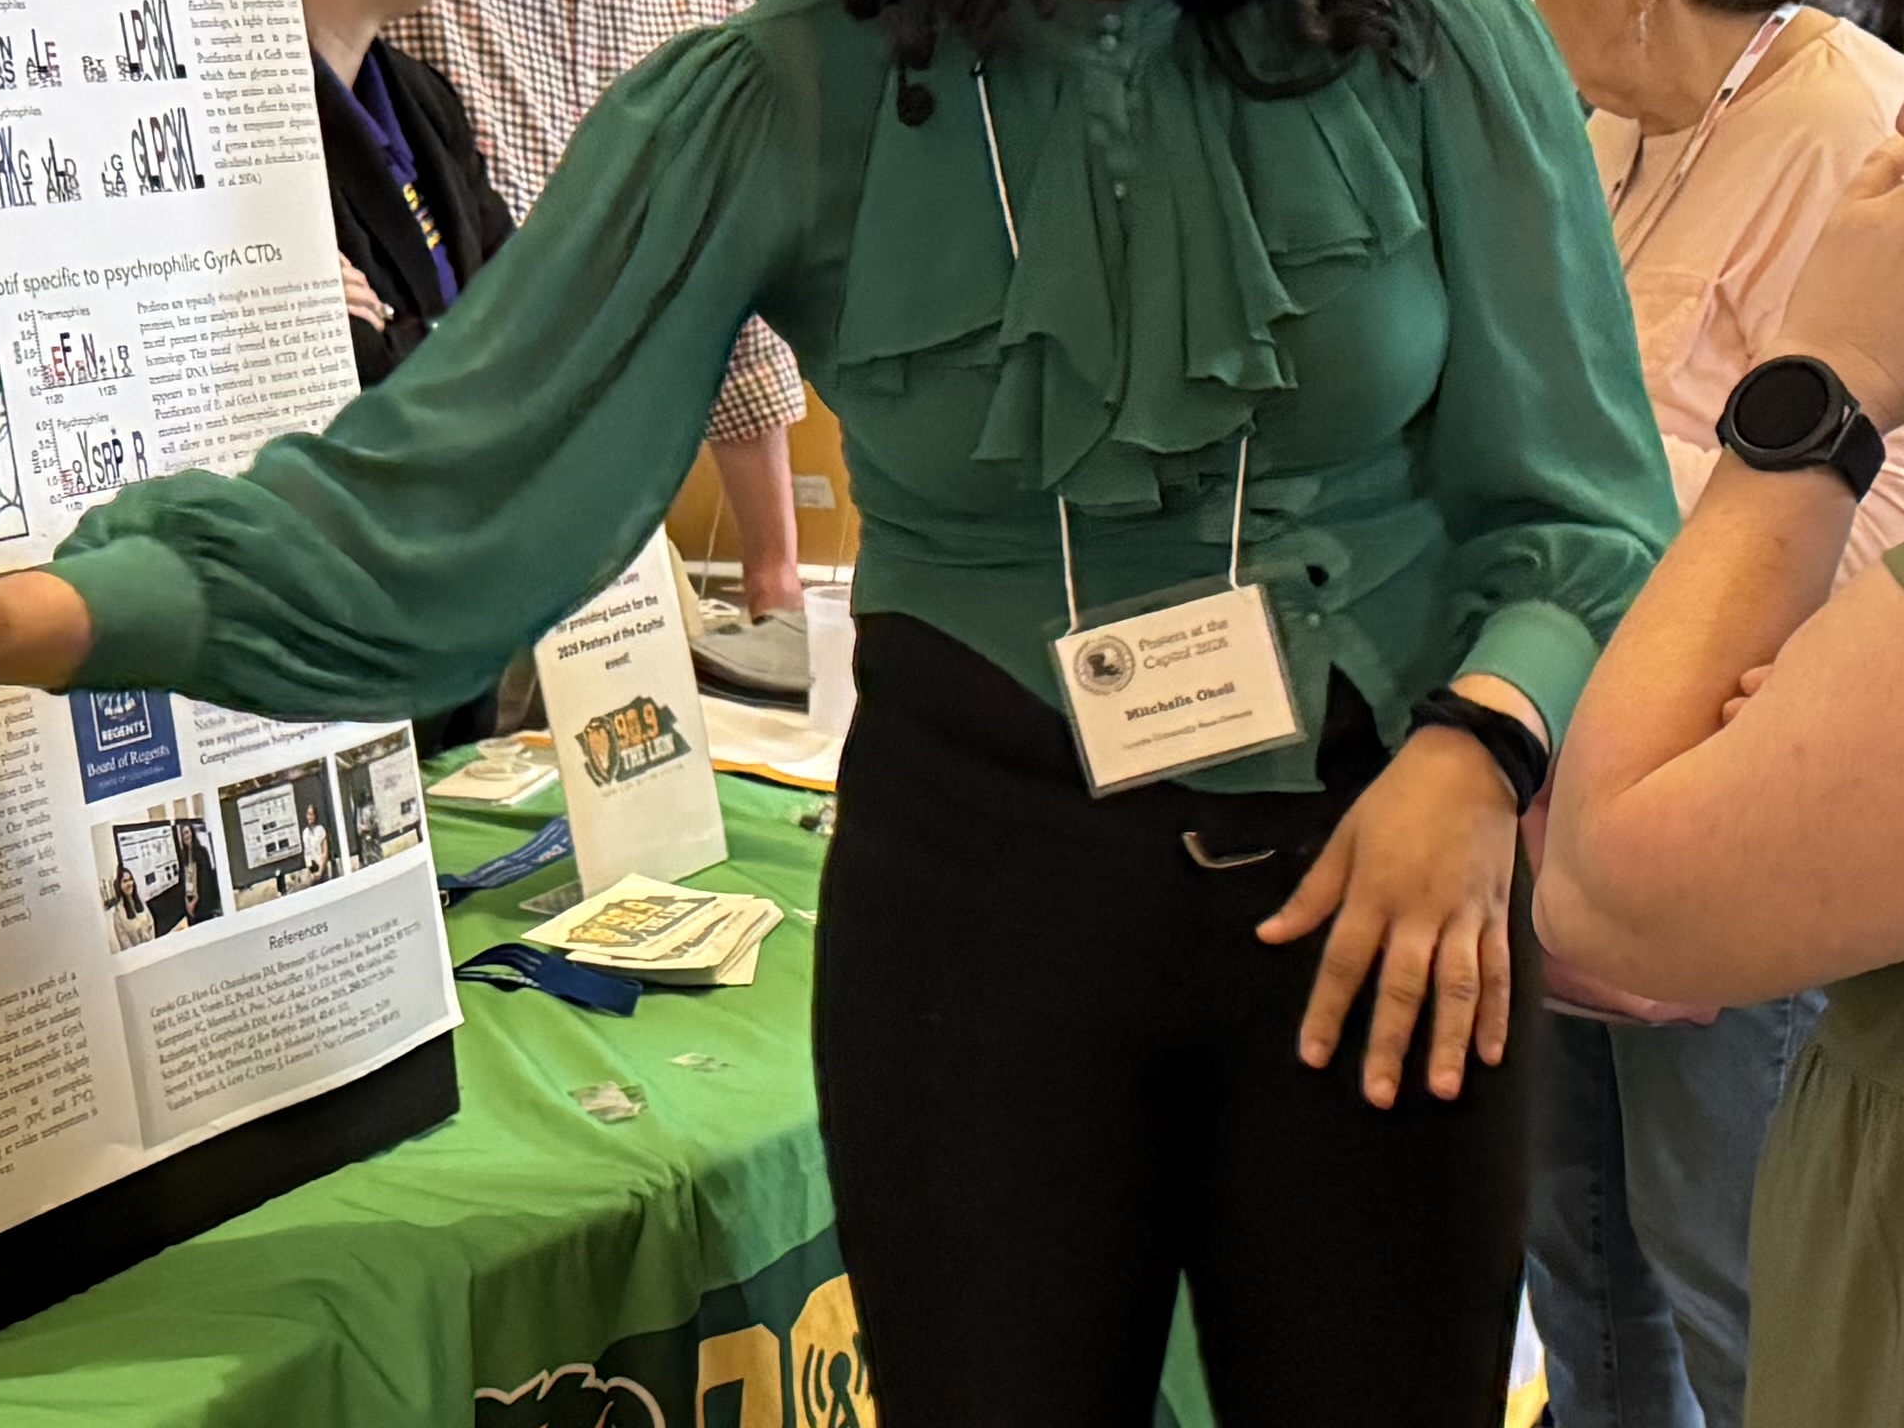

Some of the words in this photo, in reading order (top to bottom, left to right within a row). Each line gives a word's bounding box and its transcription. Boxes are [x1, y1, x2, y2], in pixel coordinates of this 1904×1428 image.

[22, 266, 81, 299] specific
[83, 269, 100, 286] to
[203, 248, 243, 275] GyrA
[244, 243, 283, 265] CTDs
